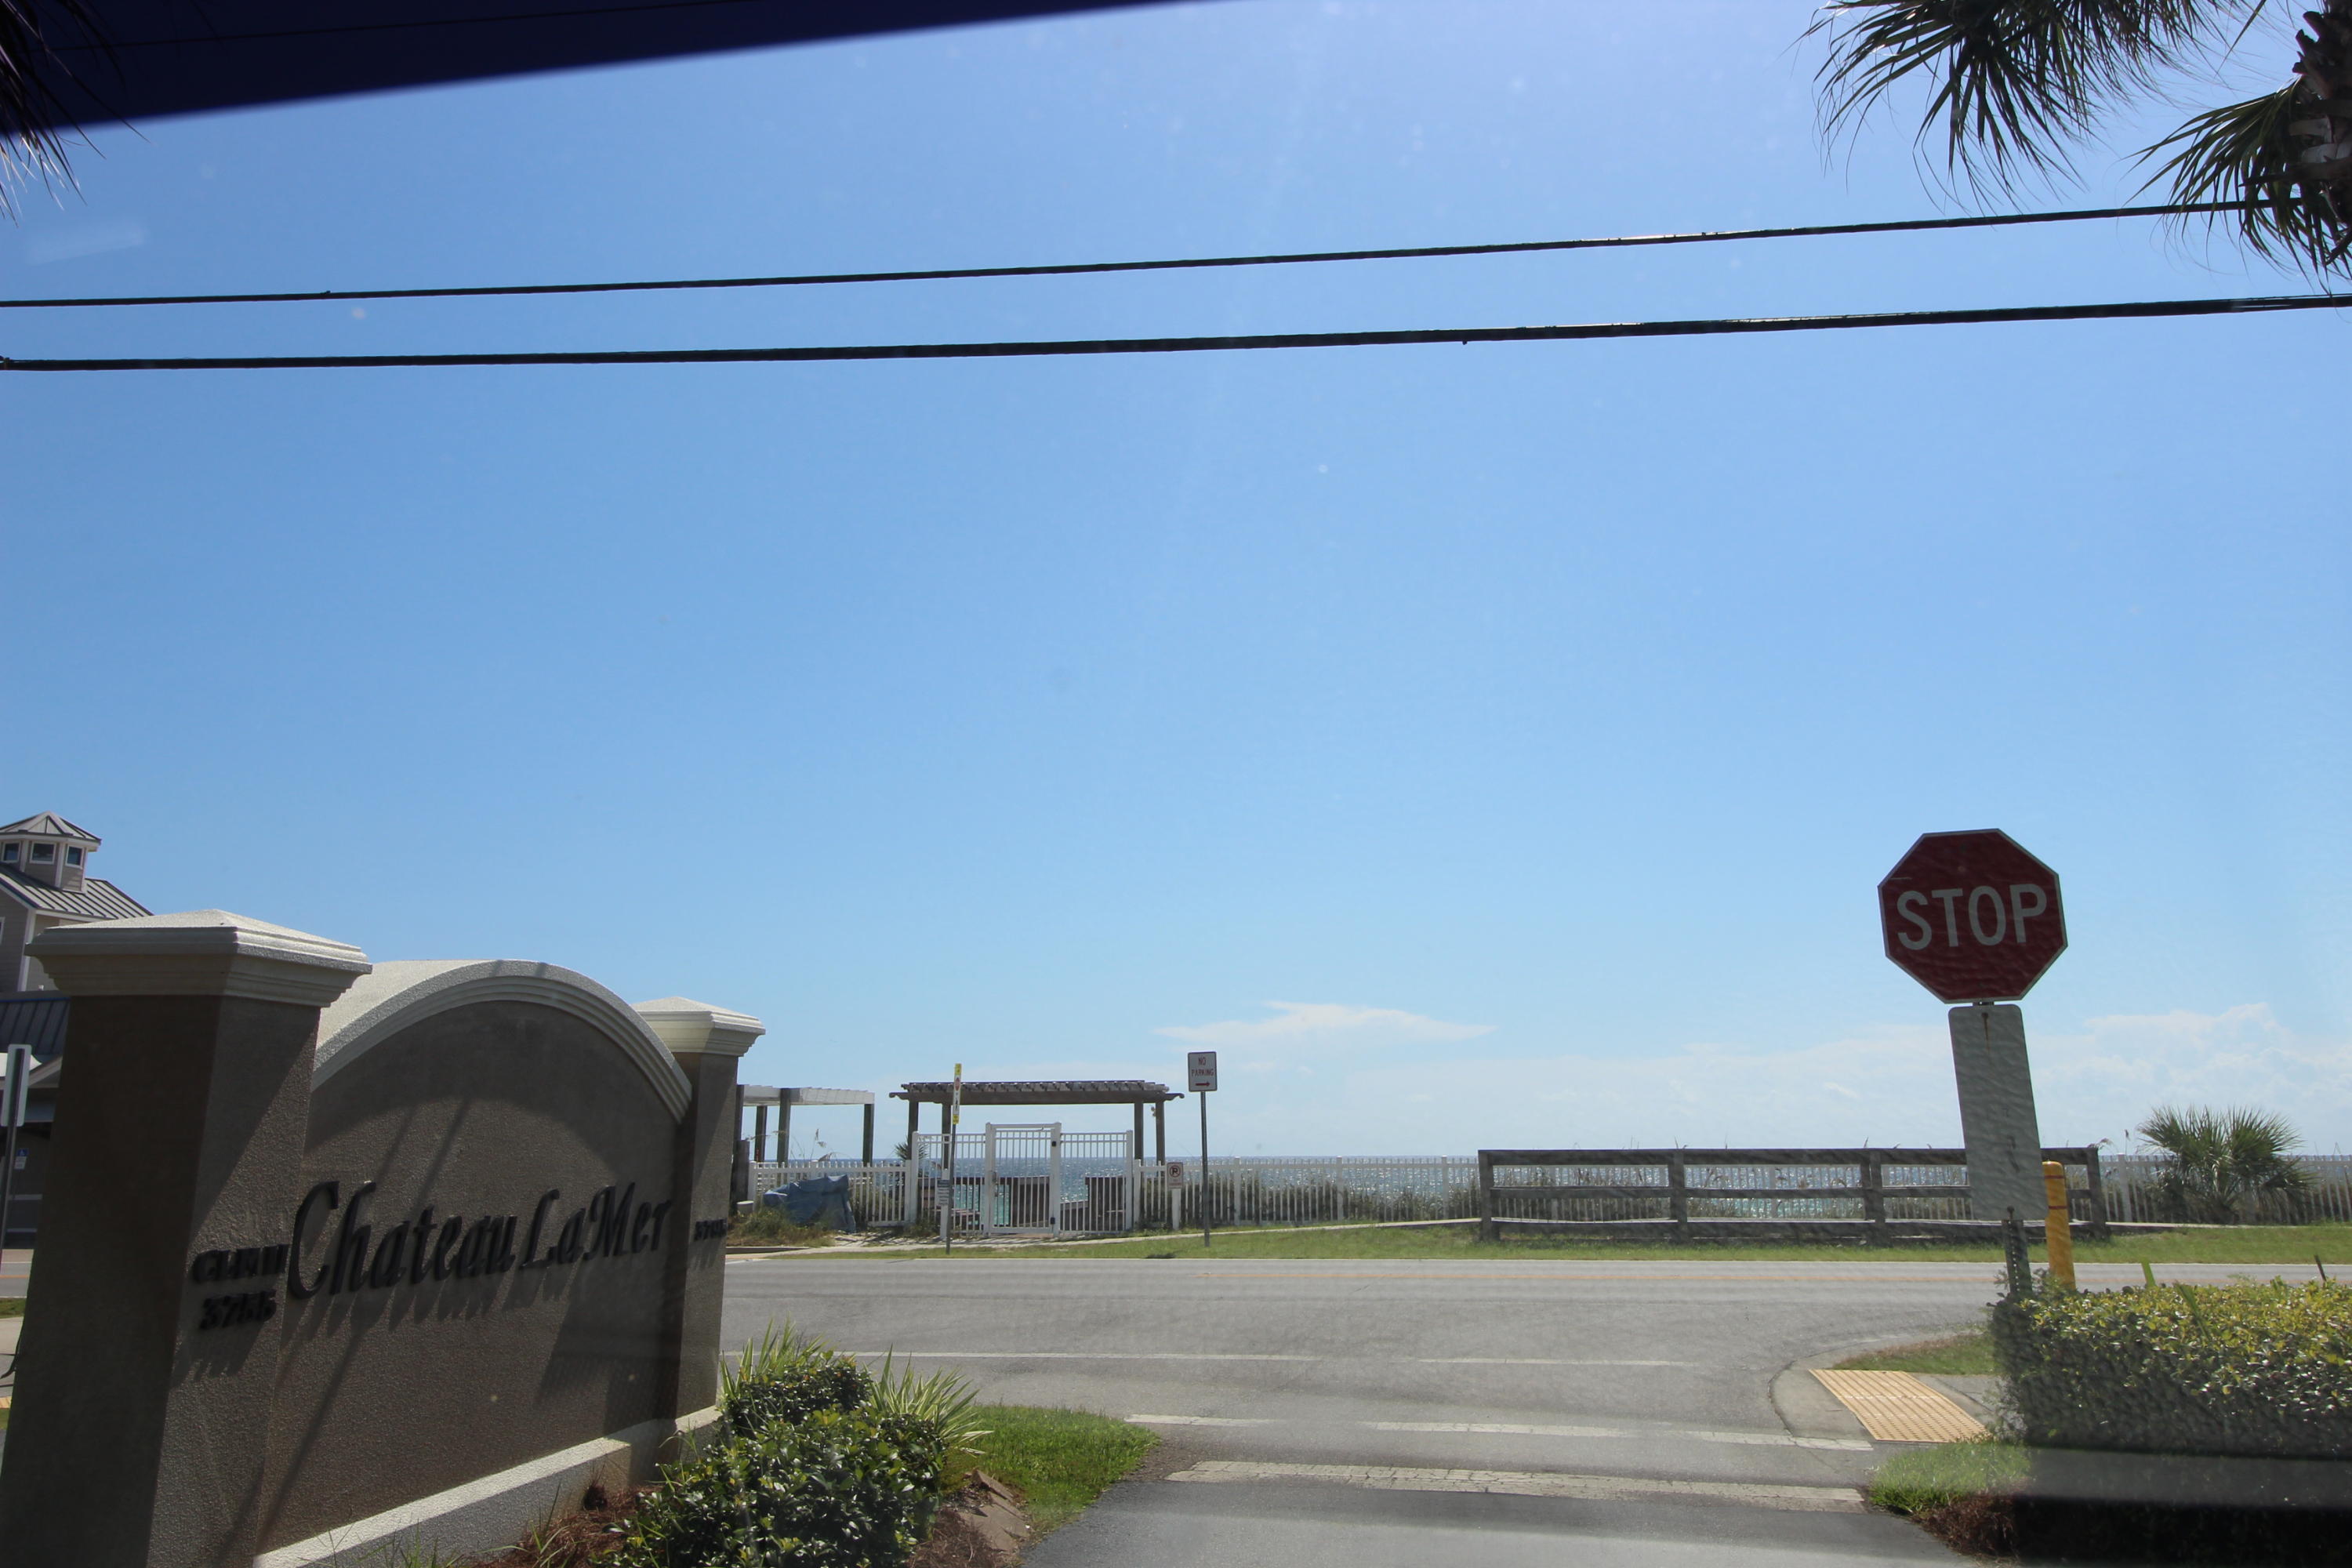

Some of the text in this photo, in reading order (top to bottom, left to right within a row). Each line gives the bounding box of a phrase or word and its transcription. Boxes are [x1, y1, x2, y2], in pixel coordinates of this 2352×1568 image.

[1896, 883, 2048, 951] STOP
[1191, 1068, 1214, 1077] PARKING
[1198, 1056, 1207, 1066] NO
[287, 1181, 517, 1299] Chateau
